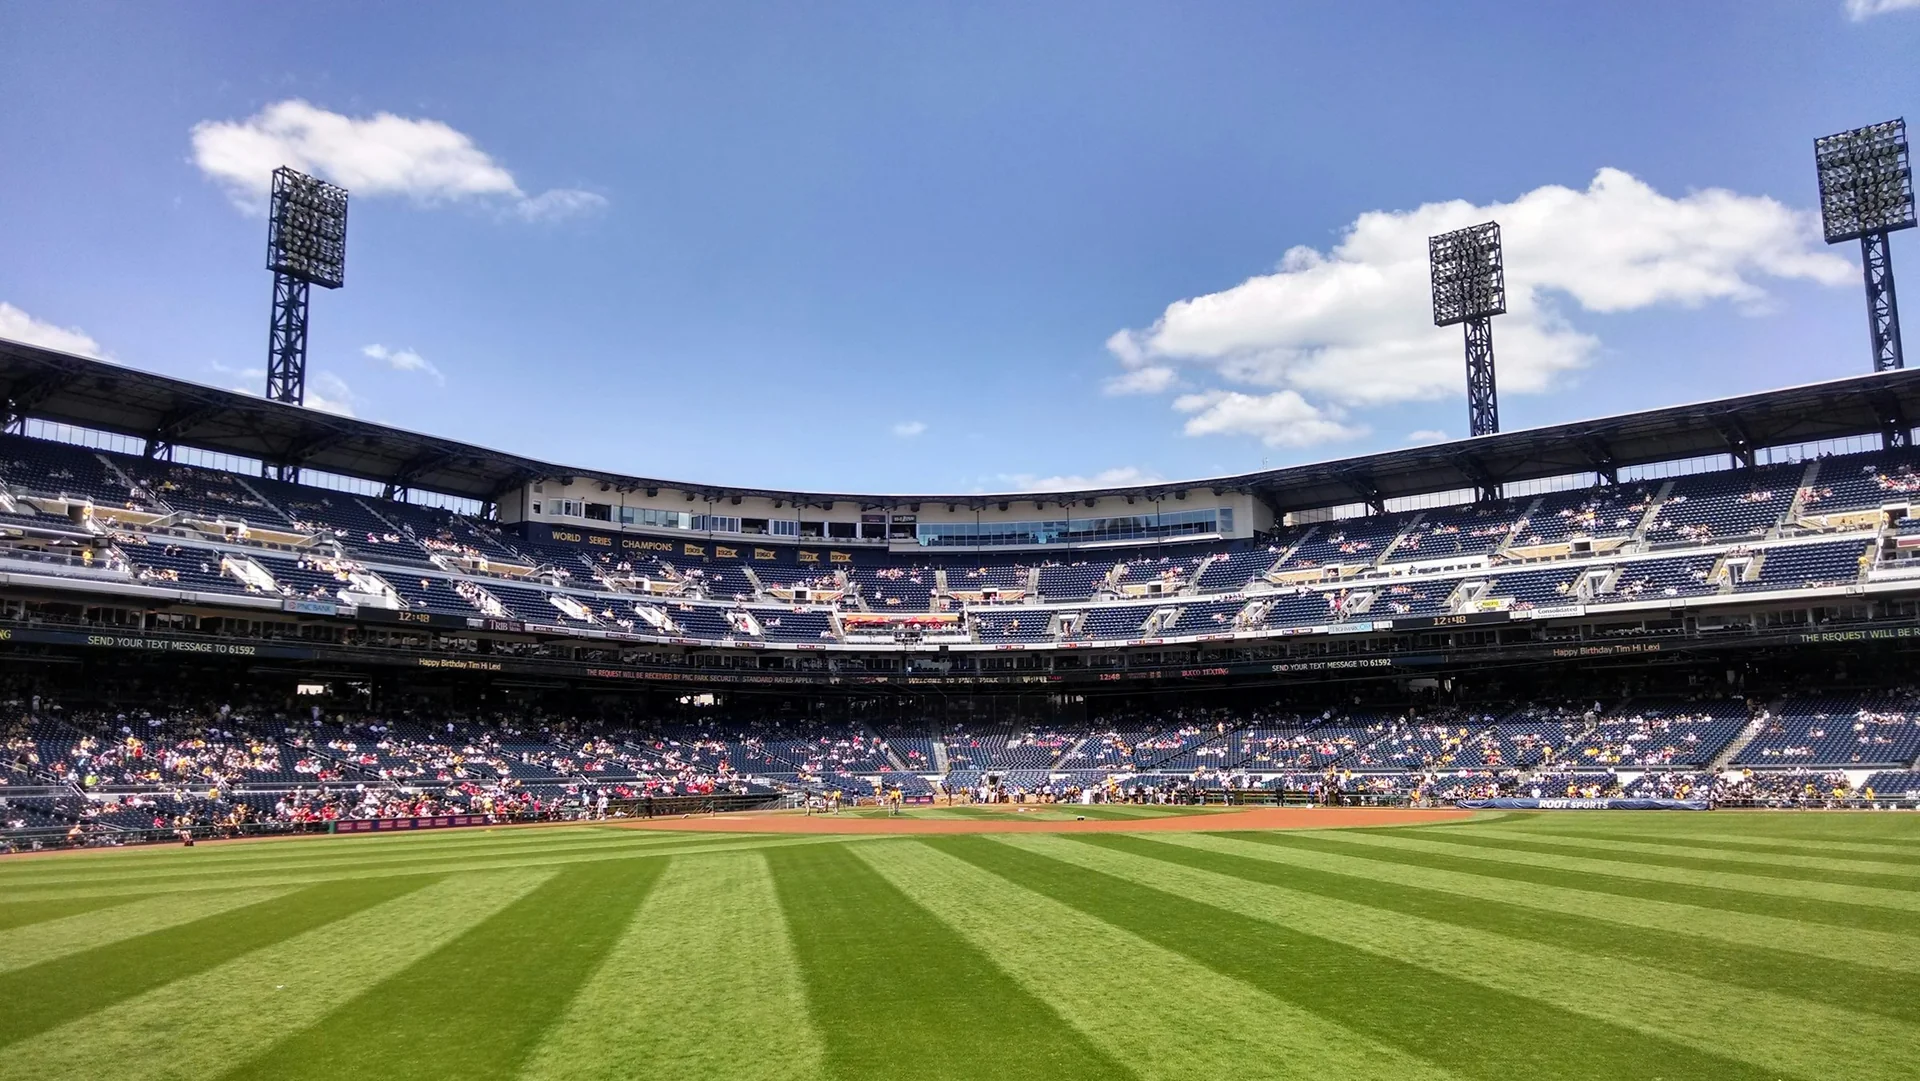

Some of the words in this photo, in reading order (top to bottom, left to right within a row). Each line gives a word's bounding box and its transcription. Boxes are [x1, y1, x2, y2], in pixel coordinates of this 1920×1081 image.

[552, 531, 581, 542] WORLD
[589, 535, 612, 546] SERIES
[622, 540, 673, 551] CHAMPIONS
[398, 611, 430, 623] 12:48
[1434, 616, 1466, 626] 12:48
[489, 620, 508, 631] TRIB
[1800, 634, 1819, 642] THE
[1822, 631, 1866, 642] REQUEST
[1870, 630, 1895, 638] WILL
[1898, 628, 1911, 637] BE
[88, 635, 114, 646] SEND
[118, 638, 142, 648] YOUR
[146, 639, 168, 649] TEXT
[172, 641, 212, 652] MESSAGE
[215, 644, 226, 653] TO
[228, 646, 256, 655] 61592
[1553, 648, 1578, 657] Happy
[1580, 646, 1613, 655] Birthday
[1614, 644, 1630, 652] Tim
[1632, 644, 1641, 652] Hi
[419, 658, 440, 667] Happy
[441, 660, 467, 669] Birthday
[468, 661, 479, 669] Tim
[1272, 664, 1288, 672] SEND
[1289, 663, 1308, 671] YOUR
[1309, 662, 1325, 670] TEXT
[1370, 658, 1392, 666] 61592
[598, 670, 622, 678] REQUEST
[623, 670, 635, 678] WILL
[645, 672, 672, 680] RECEIVED
[774, 676, 794, 684] RATES
[1539, 800, 1569, 809] ROOT
[1570, 800, 1608, 810] SPORTS
